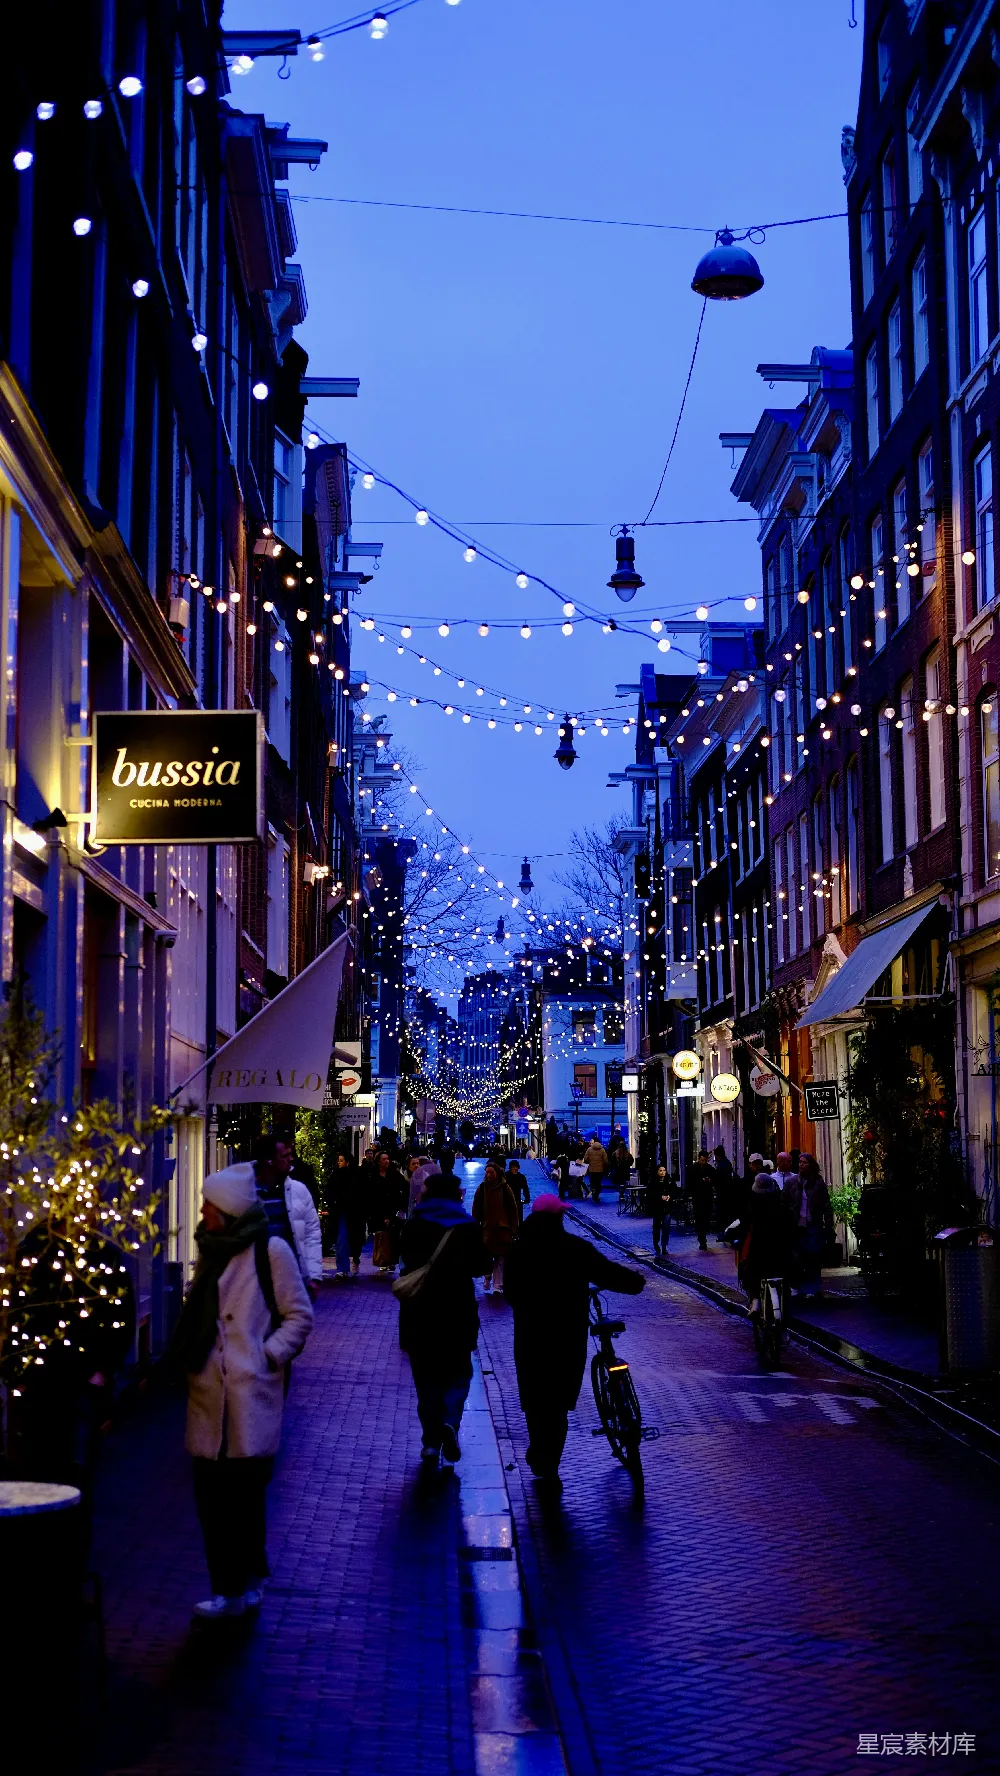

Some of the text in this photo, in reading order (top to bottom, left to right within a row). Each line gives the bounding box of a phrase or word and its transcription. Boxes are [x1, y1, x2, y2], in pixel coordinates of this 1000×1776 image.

[112, 746, 241, 787] bussia
[129, 798, 222, 808] CUCINA MODERNA
[213, 1069, 322, 1092] REGALO
